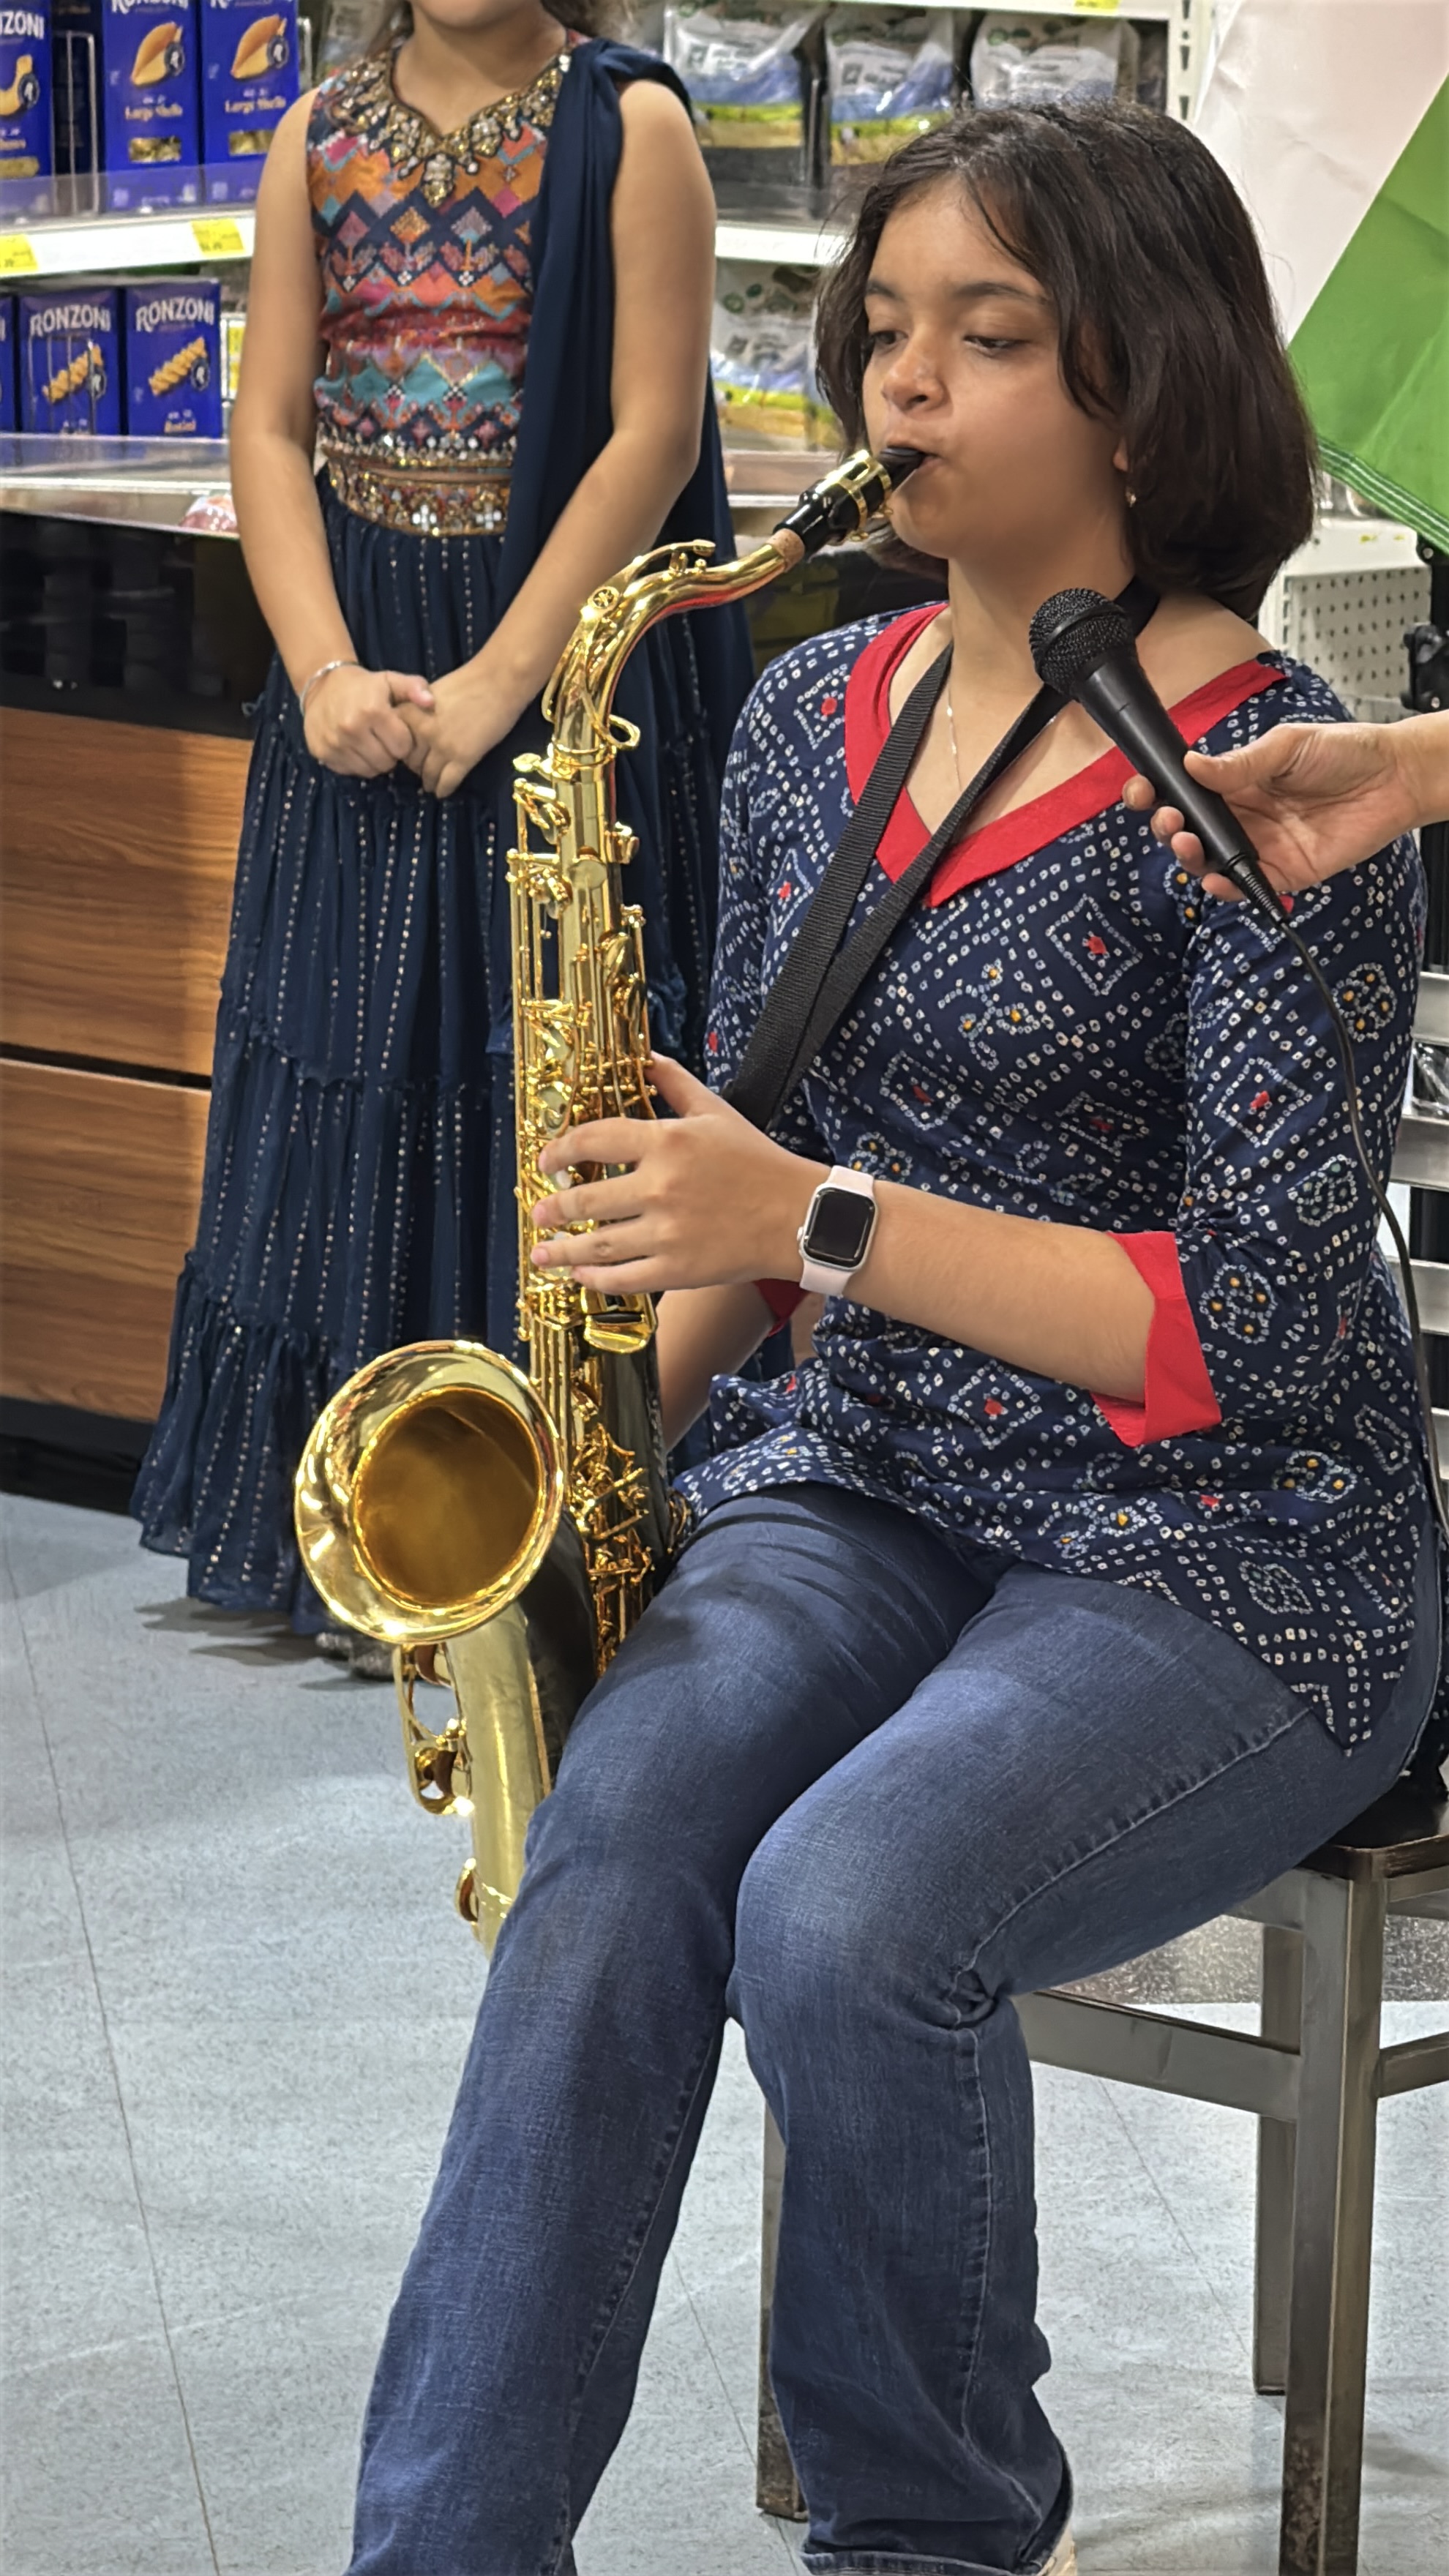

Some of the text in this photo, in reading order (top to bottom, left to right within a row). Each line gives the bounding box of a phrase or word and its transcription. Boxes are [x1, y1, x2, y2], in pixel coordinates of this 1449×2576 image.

[0, 10, 44, 40] ZONI
[30, 304, 111, 337] RONZONI
[136, 296, 214, 332] RONZONI
